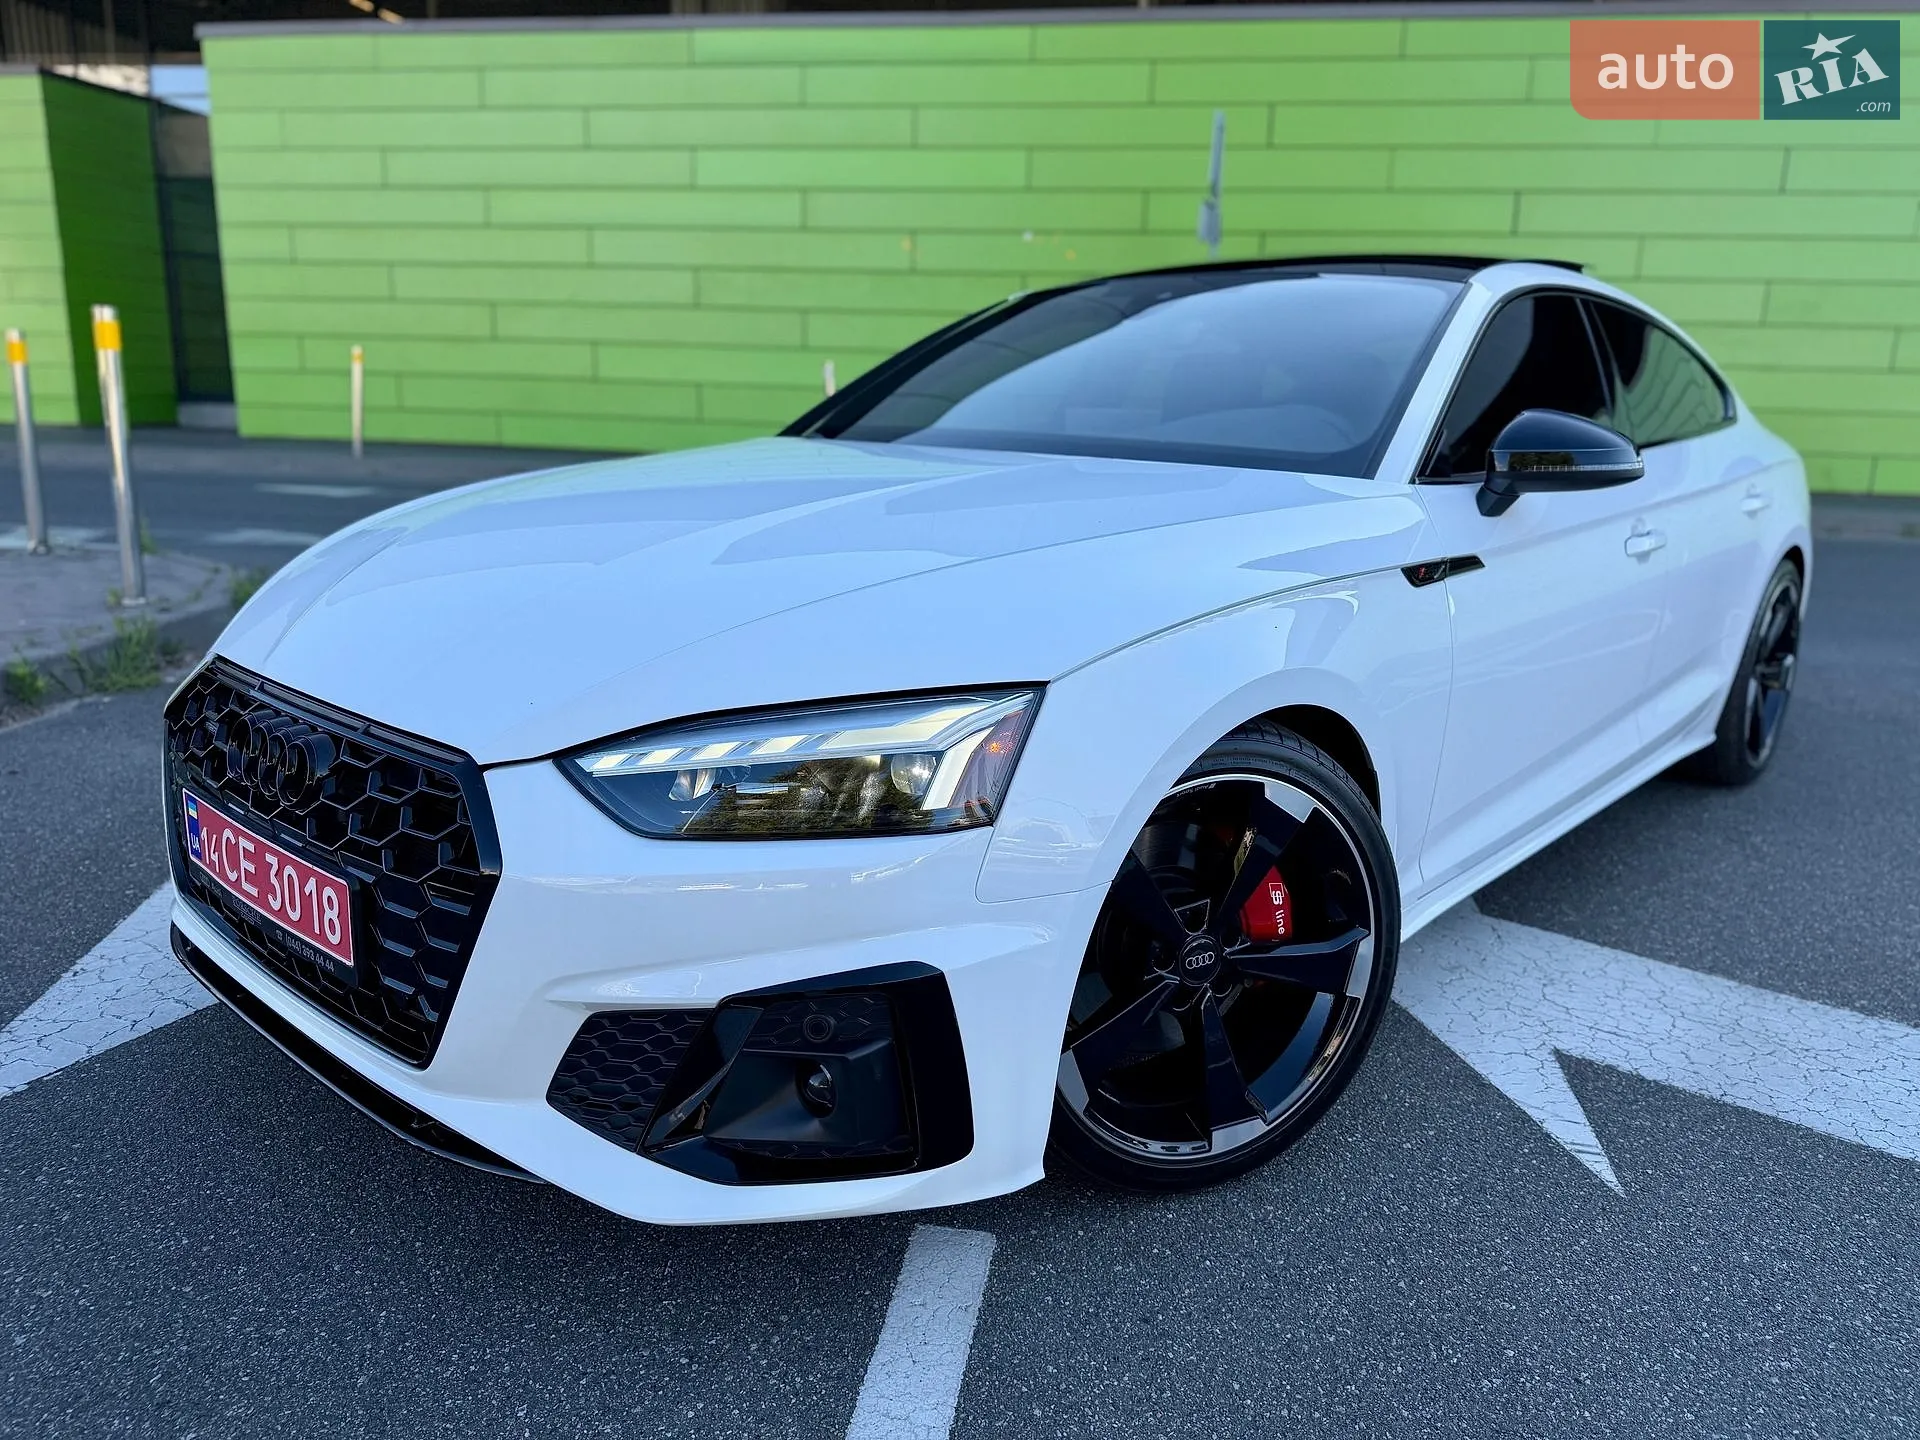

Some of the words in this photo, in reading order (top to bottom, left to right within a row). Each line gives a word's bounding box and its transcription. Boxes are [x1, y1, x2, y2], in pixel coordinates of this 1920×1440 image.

[190, 833, 200, 852] UA
[265, 853, 341, 945] 3018
[1275, 910, 1285, 935] line
